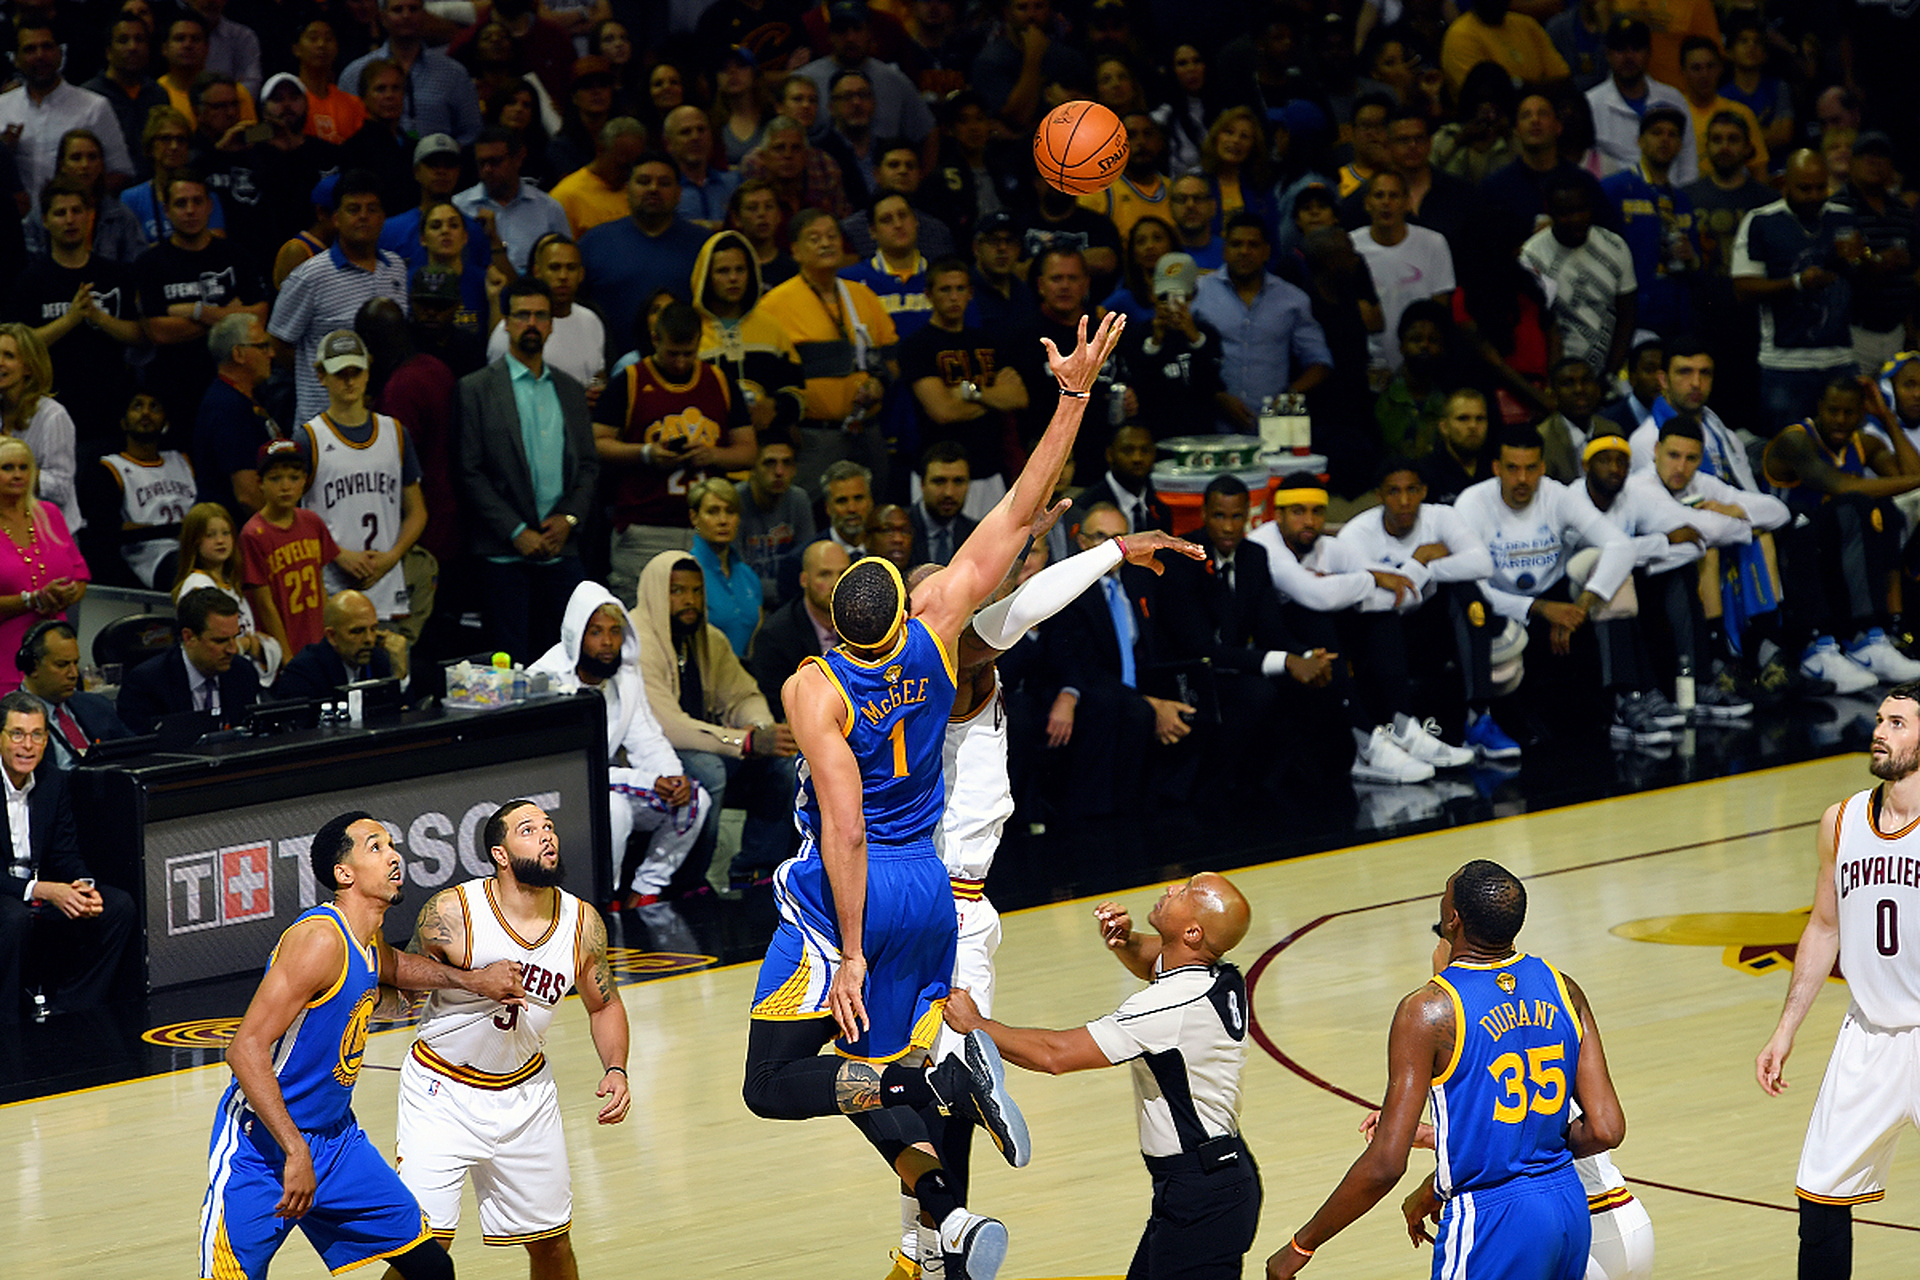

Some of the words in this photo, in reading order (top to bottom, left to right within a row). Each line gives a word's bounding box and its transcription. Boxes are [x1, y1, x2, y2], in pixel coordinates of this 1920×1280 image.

[362, 512, 378, 552] 2
[284, 565, 319, 615] 23
[861, 678, 929, 725] McGEE
[887, 718, 910, 778] 1
[173, 864, 211, 921] T
[1876, 899, 1899, 956] 0
[1229, 990, 1242, 1030] 8
[1479, 999, 1559, 1042] DURANT
[1487, 1040, 1566, 1124] 35
